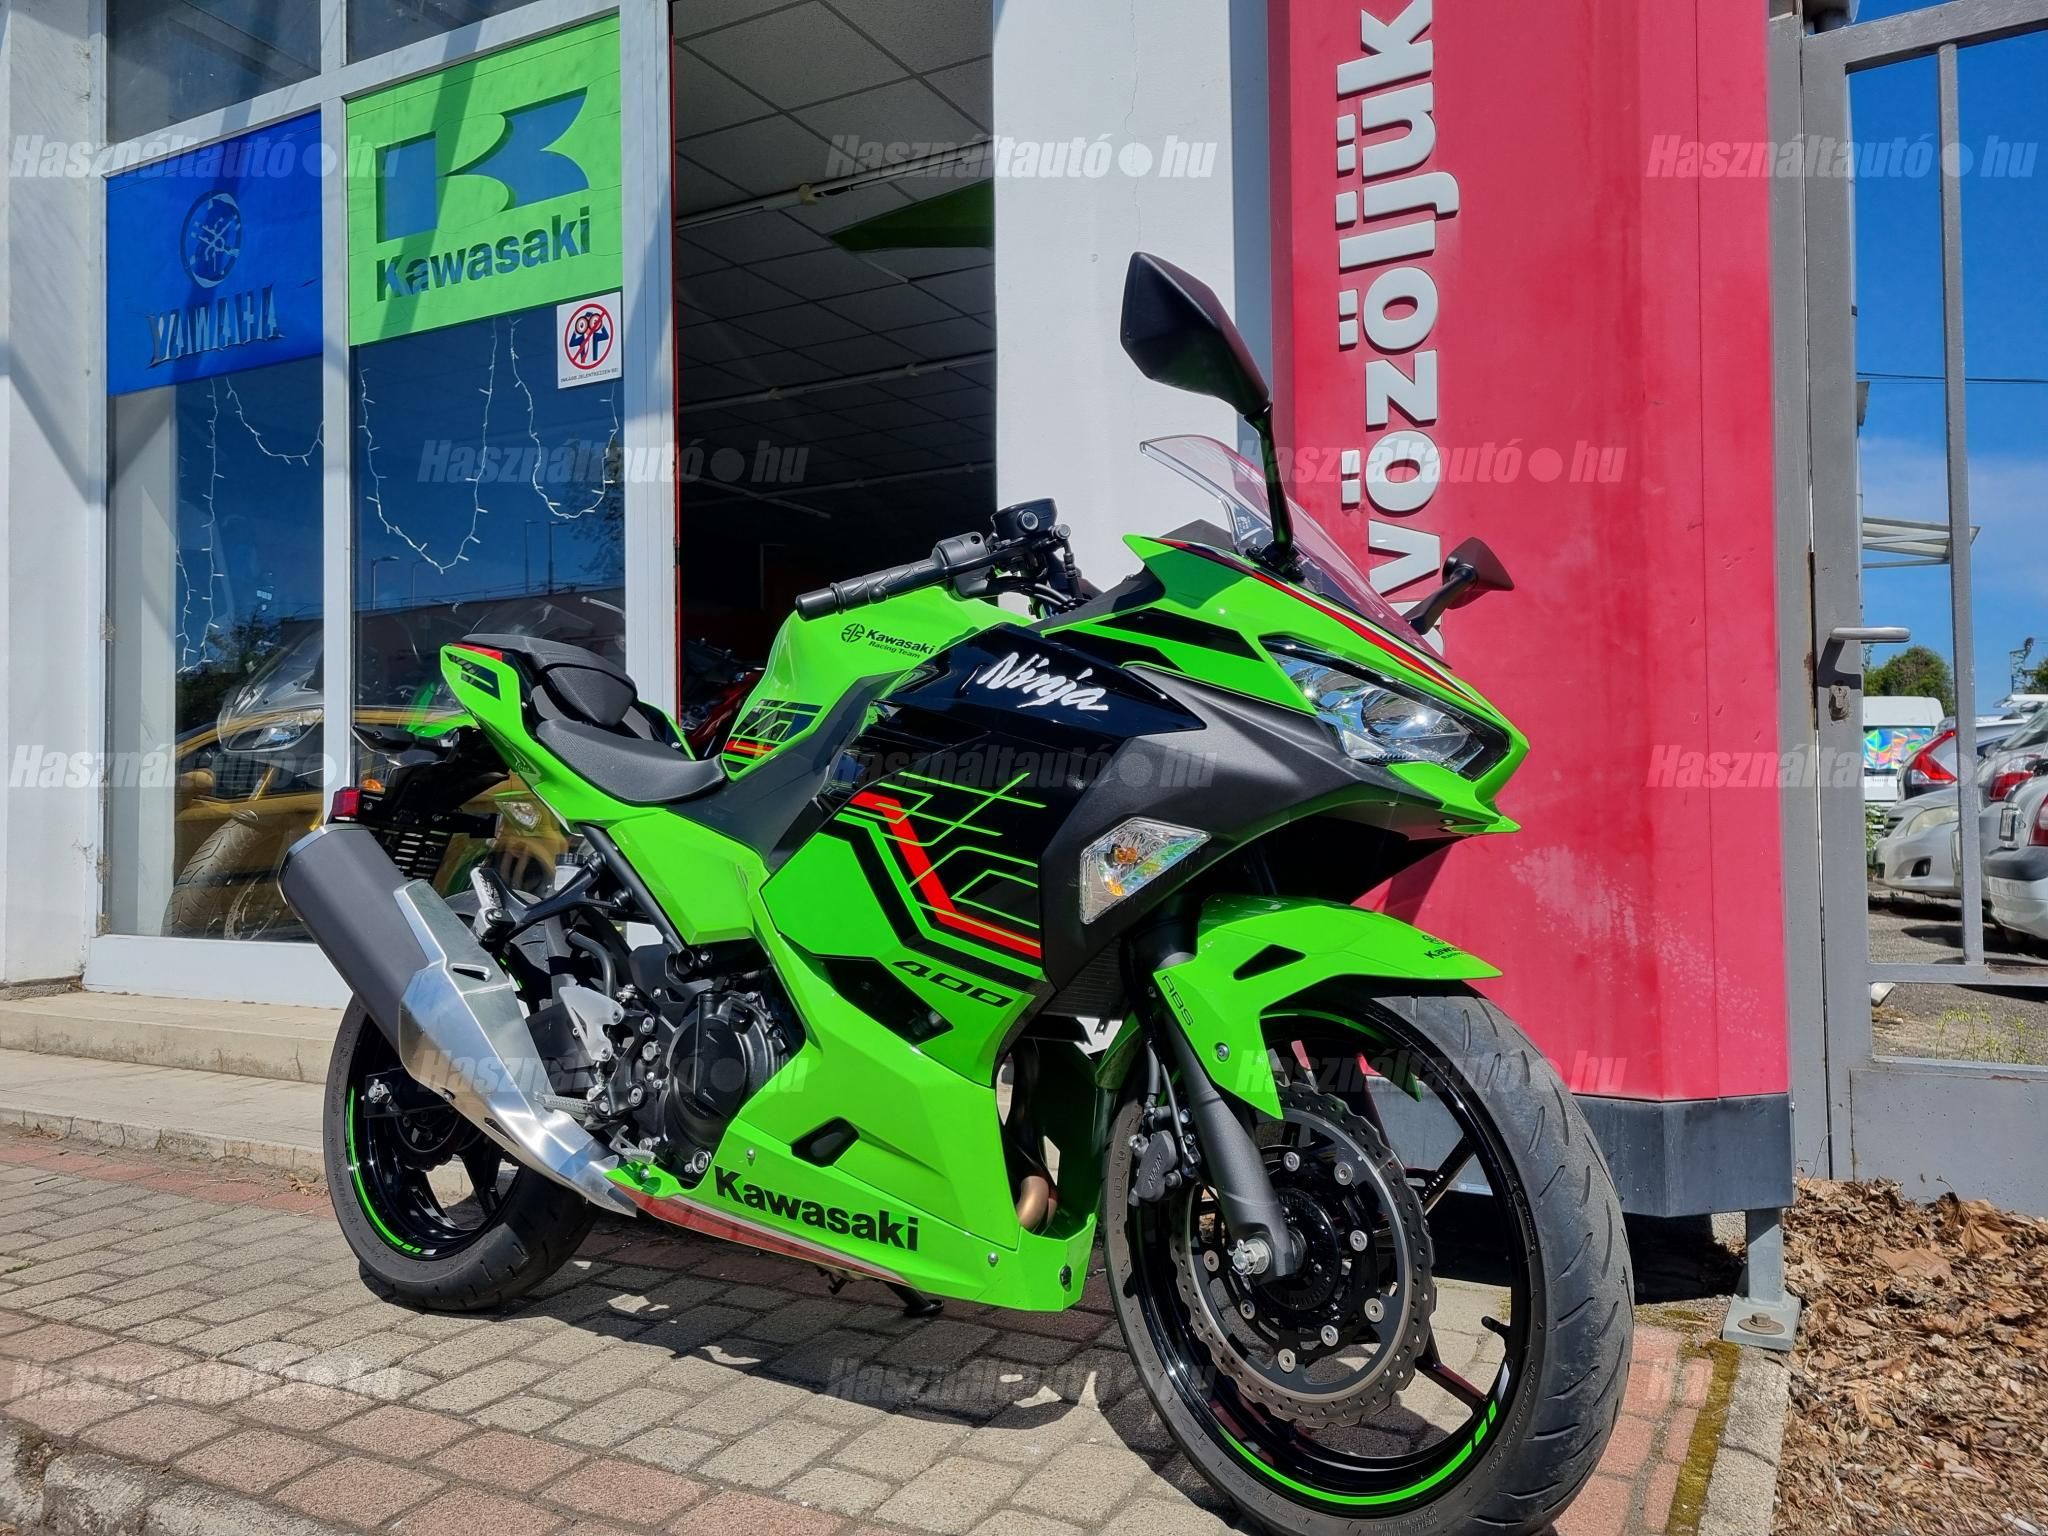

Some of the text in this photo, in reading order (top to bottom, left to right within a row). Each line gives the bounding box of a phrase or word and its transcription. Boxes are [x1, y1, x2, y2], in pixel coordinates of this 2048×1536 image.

[376, 206, 591, 302] Kawasaki
[146, 283, 285, 369] YAMAHA
[1335, 0, 1460, 656] vözöljük
[866, 629, 936, 655] Kawasaki
[868, 640, 921, 659] Racing Team
[976, 652, 1109, 711] Ninja
[891, 961, 1015, 1008] 400
[1162, 975, 1194, 1026] ABS
[714, 1165, 919, 1252] Kawasaki
